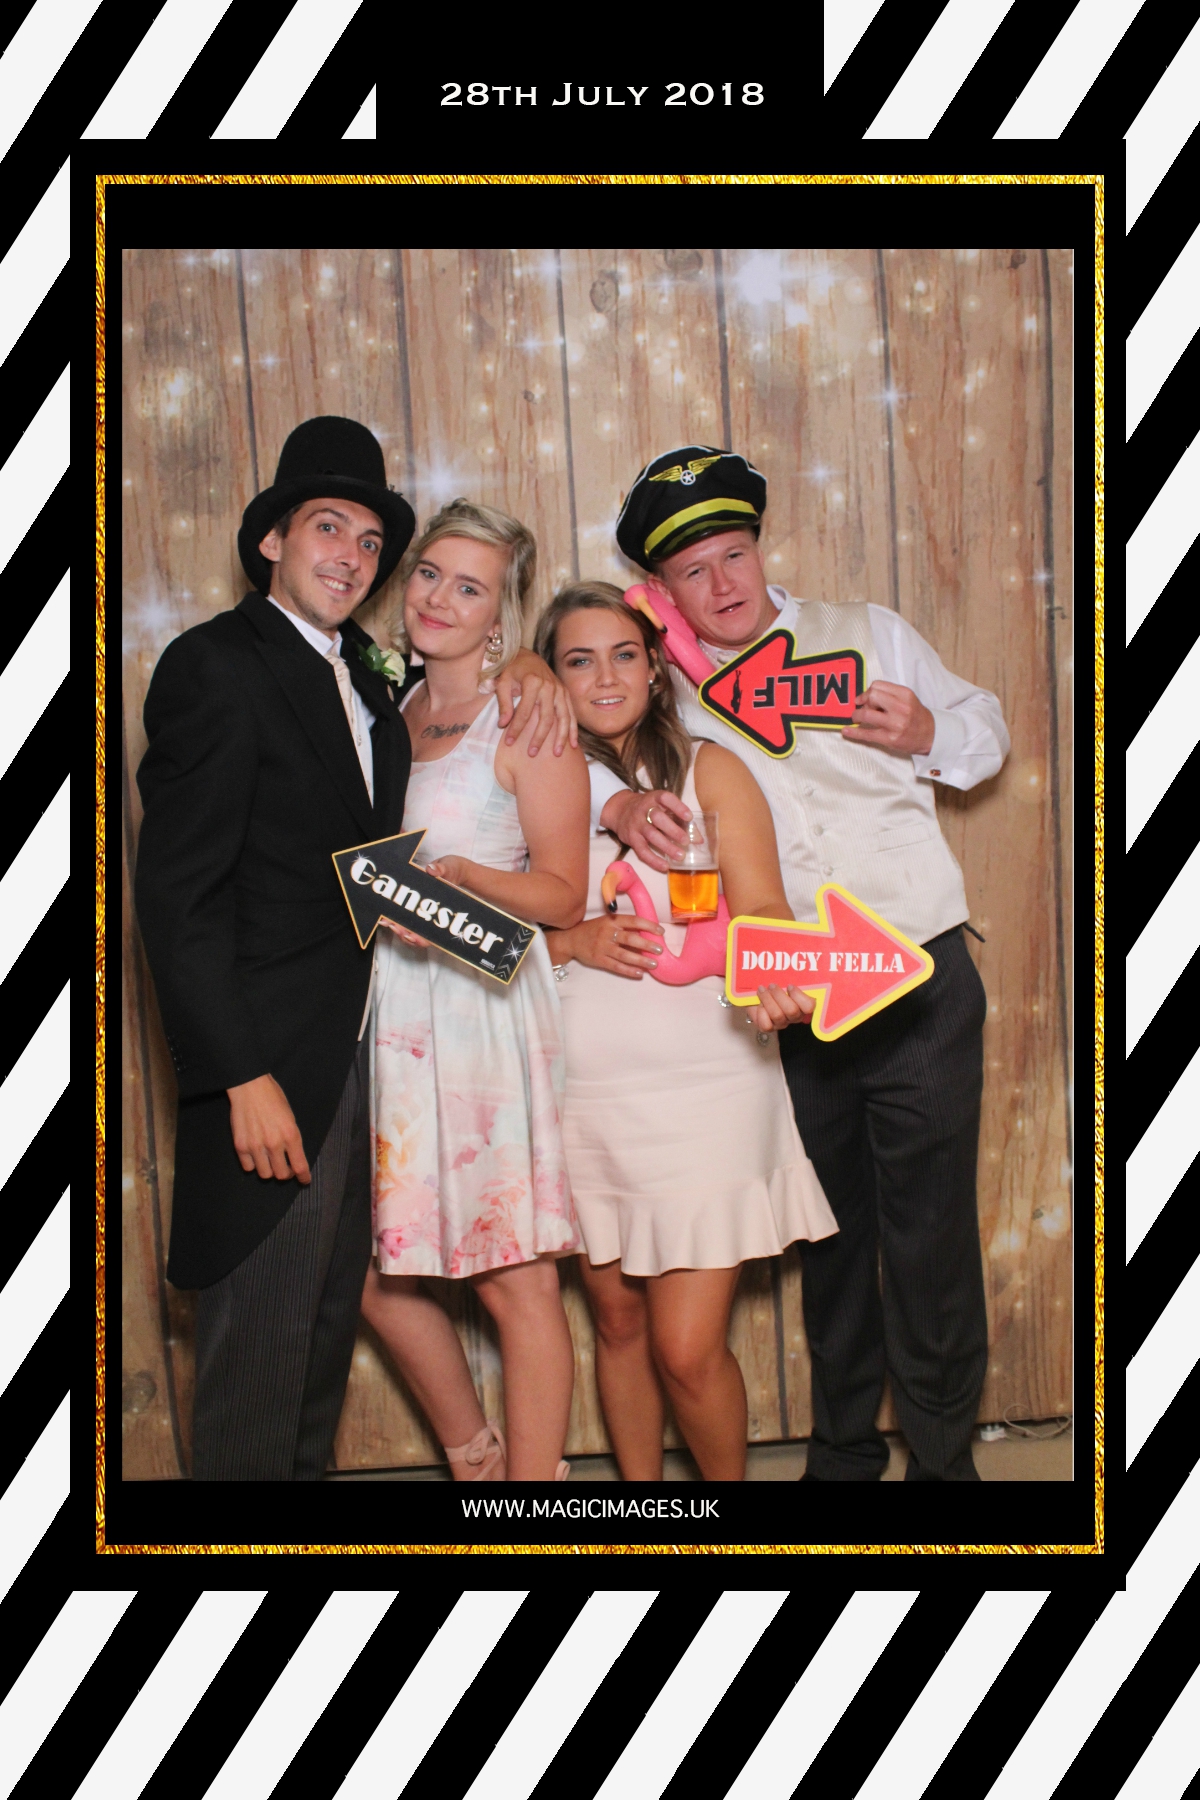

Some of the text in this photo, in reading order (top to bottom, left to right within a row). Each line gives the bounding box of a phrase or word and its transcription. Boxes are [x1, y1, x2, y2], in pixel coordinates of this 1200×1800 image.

[752, 672, 850, 710] MILF
[350, 856, 504, 954] Gangster
[741, 950, 906, 974] DODGY FELLA
